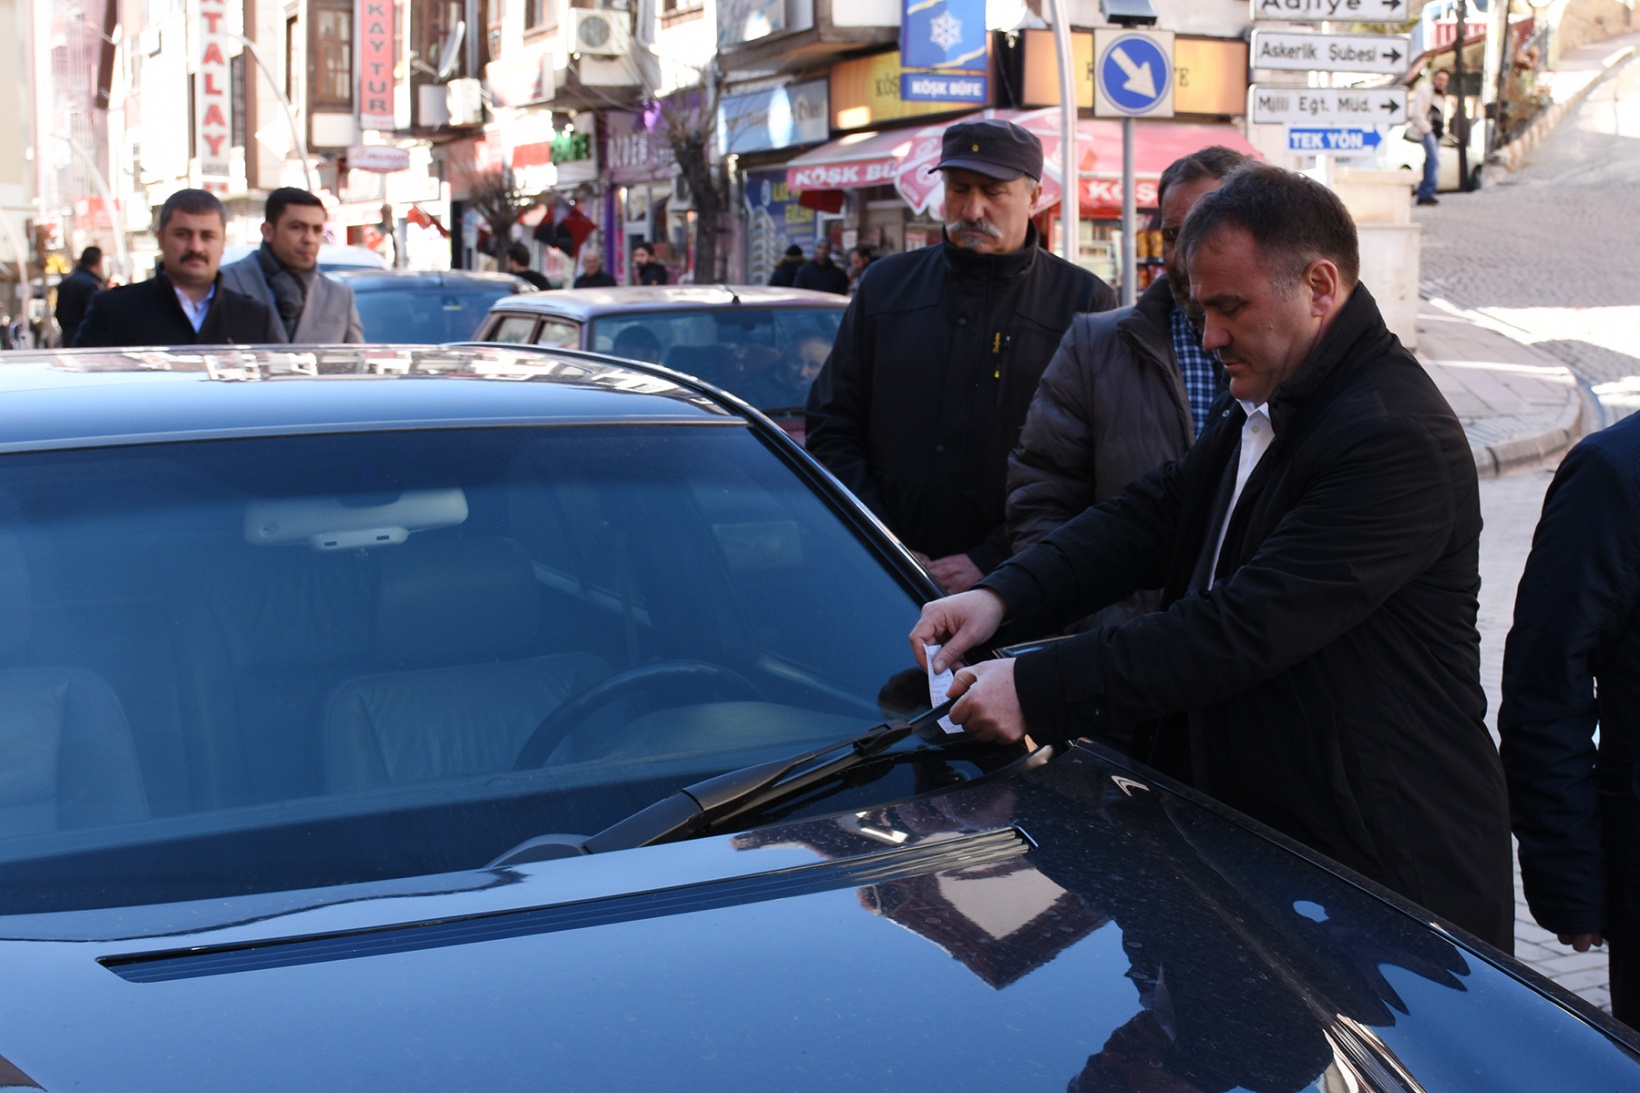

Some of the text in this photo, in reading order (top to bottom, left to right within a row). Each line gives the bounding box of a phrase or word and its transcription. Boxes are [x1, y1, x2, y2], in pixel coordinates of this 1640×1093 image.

[1260, 41, 1377, 63] Askerlik Şubesi
[202, 0, 226, 157] TALAY
[367, 63, 387, 112] TUR
[911, 79, 983, 97] KÖŞK BÜFE
[1291, 129, 1363, 148] TEK YÖN
[794, 165, 860, 187] KÖŞK
